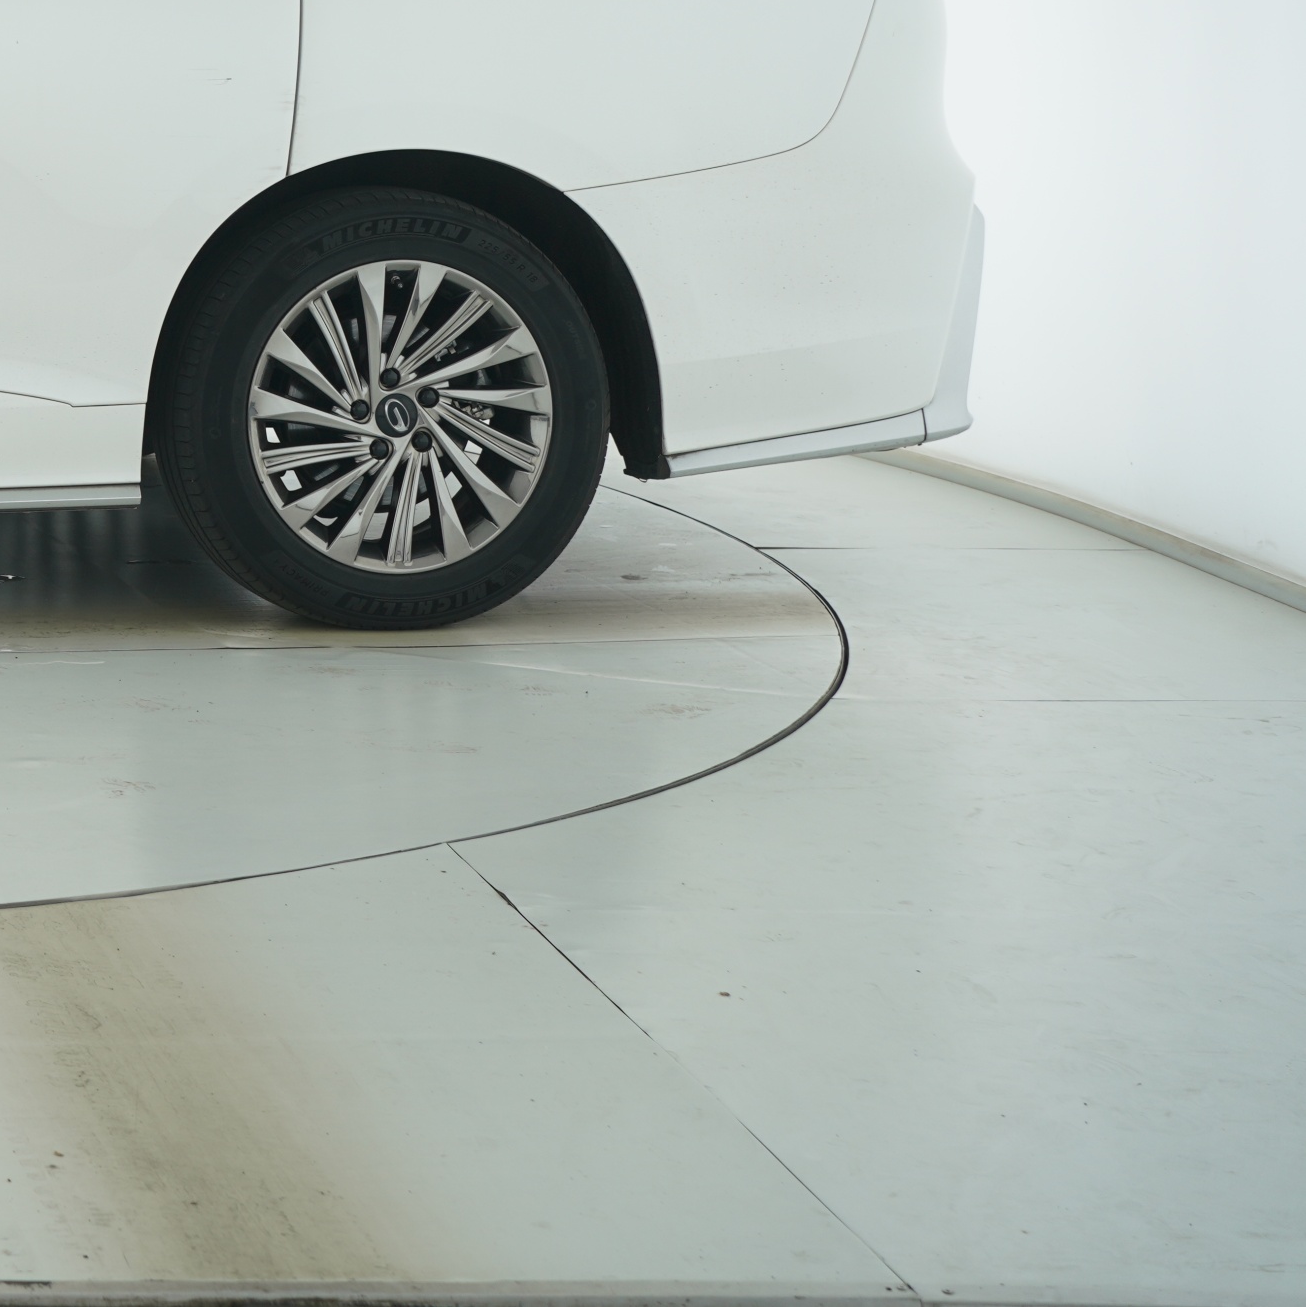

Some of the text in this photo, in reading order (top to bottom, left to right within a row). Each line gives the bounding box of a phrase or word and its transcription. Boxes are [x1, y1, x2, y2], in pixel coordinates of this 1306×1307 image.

[320, 219, 462, 251] MICHELIN
[478, 238, 538, 284] 225/55 R 18
[279, 562, 329, 597] PRIMACY
[345, 582, 489, 615] MICHELIN
